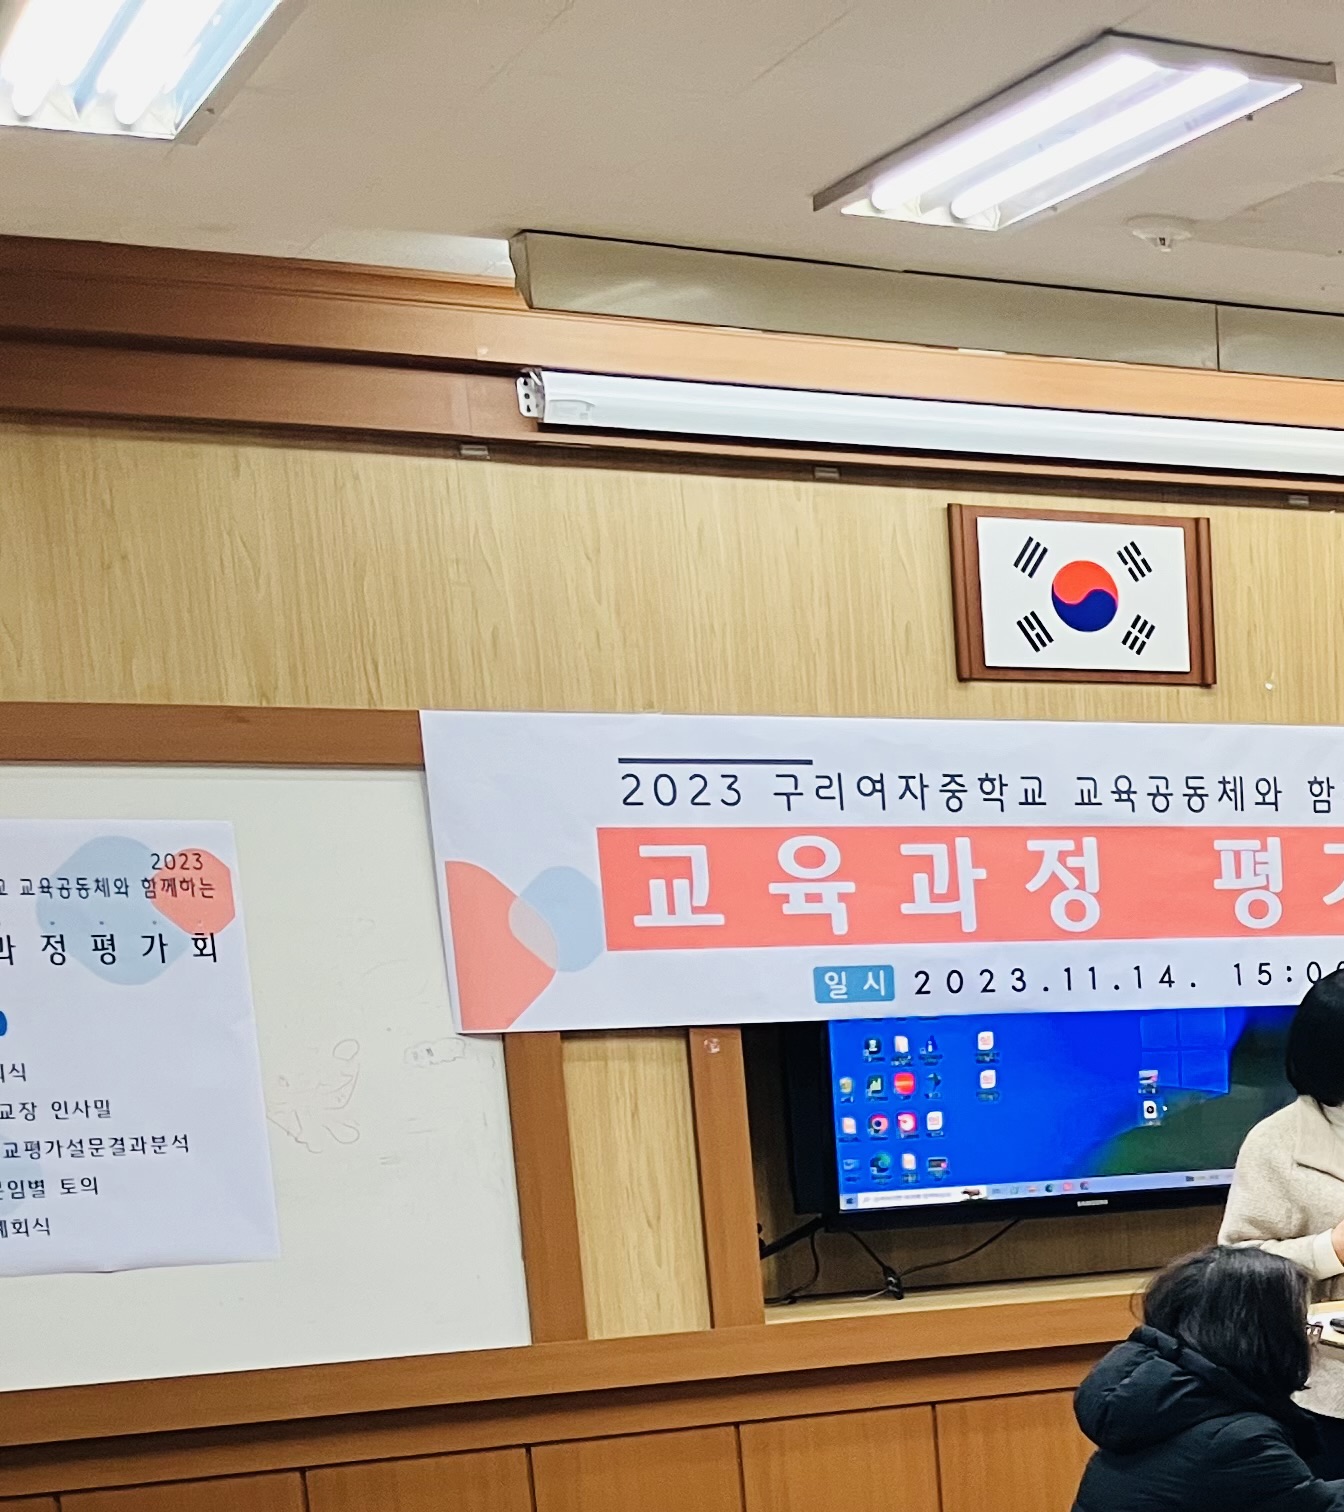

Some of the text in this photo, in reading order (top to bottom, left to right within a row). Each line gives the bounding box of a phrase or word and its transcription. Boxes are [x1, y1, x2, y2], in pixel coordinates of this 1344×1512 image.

[620, 772, 742, 808] 2023
[773, 771, 1048, 814] 구리여자중학교
[1074, 773, 1283, 814] 교육공동체와
[150, 852, 204, 871] 2023
[19, 877, 130, 899] 교육공동체와
[140, 877, 215, 899] 함께하는
[633, 835, 1102, 935] 교육과정
[824, 970, 886, 999] 일시
[0, 1176, 99, 1201] 임별 토의
